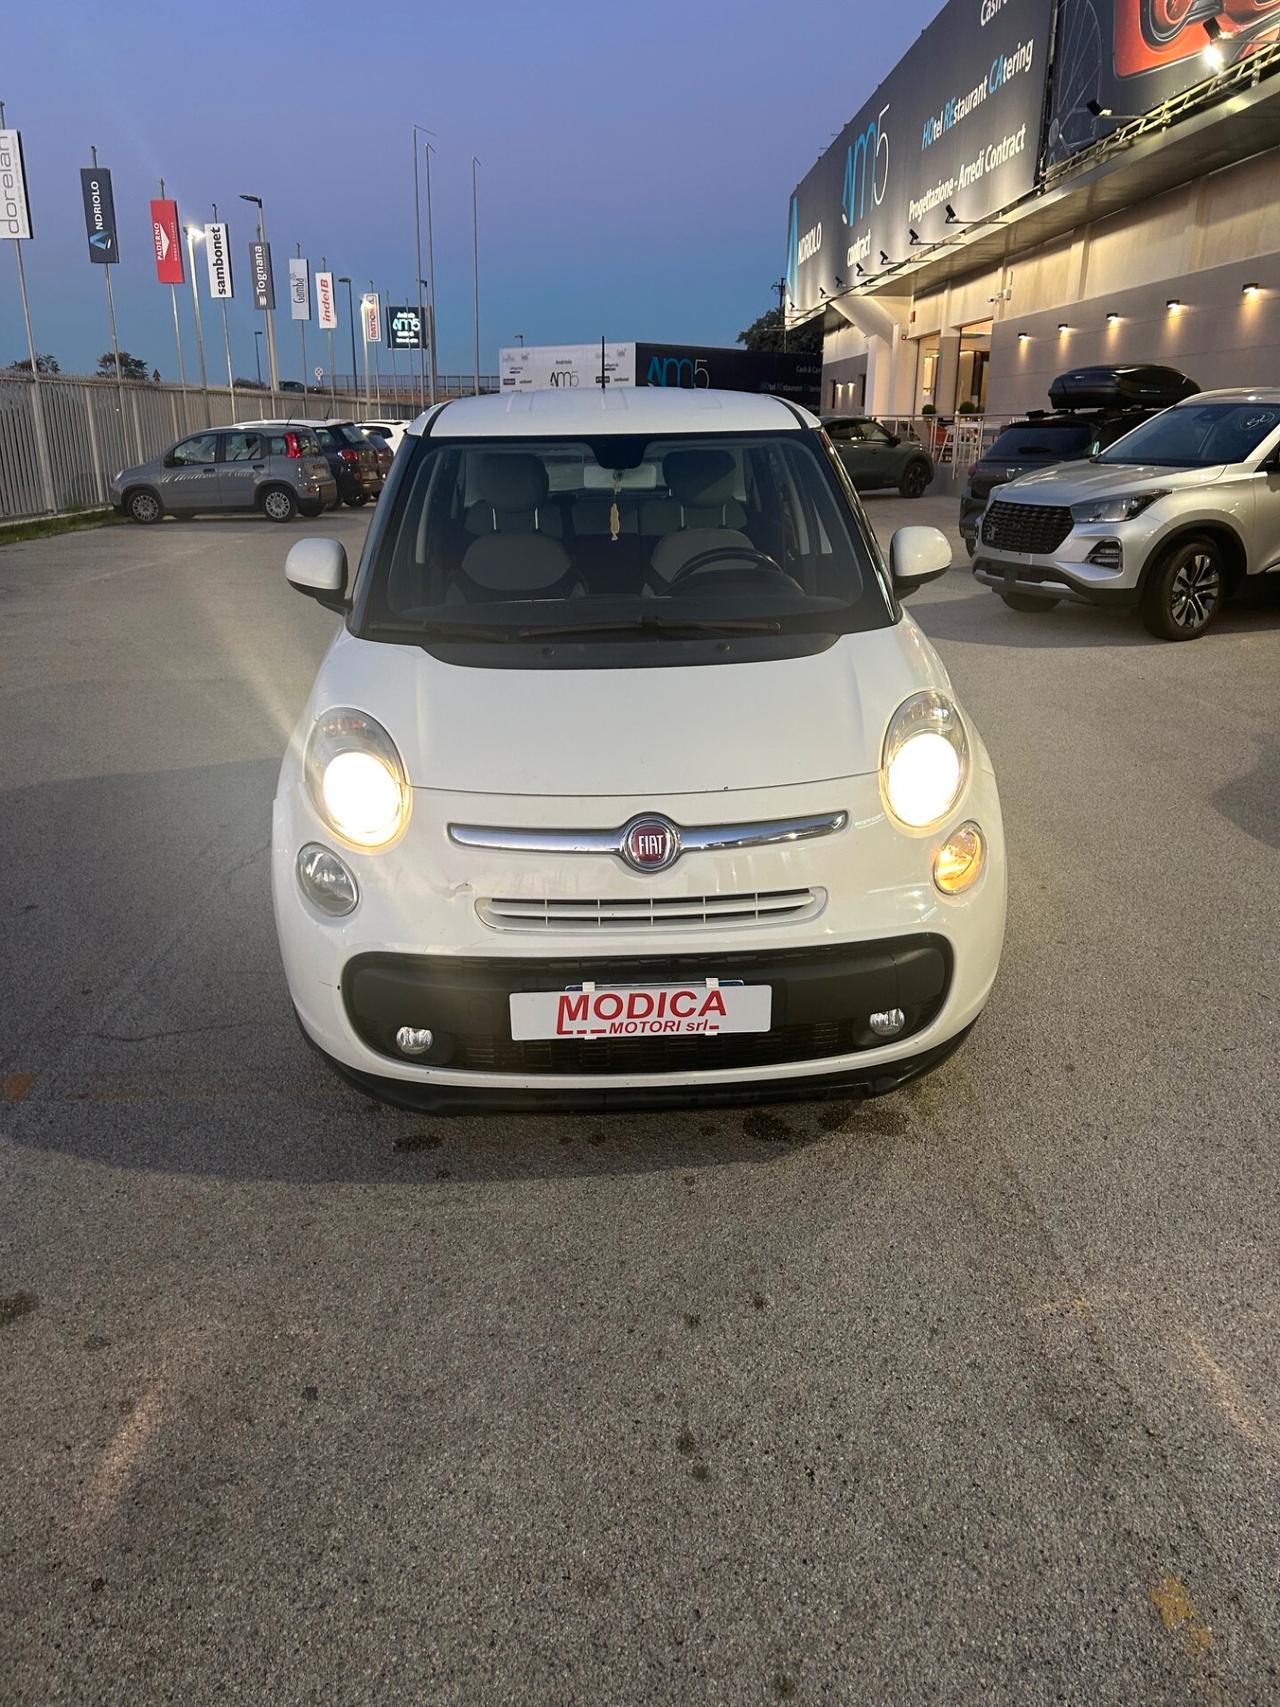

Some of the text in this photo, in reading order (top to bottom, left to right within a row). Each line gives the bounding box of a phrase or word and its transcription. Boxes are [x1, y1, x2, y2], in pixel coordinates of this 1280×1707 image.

[922, 38, 1034, 150] HOtel REstaurant CAtering
[908, 178, 954, 222] Progettazione
[957, 149, 985, 191] Arredi
[984, 123, 1026, 172] Contract
[210, 226, 226, 295] sambonet
[254, 245, 268, 295] Tognana
[847, 229, 871, 267] contract
[638, 834, 664, 856] FIAT
[557, 990, 727, 1023] MODICA
[608, 1019, 708, 1035] MOTORI srl
